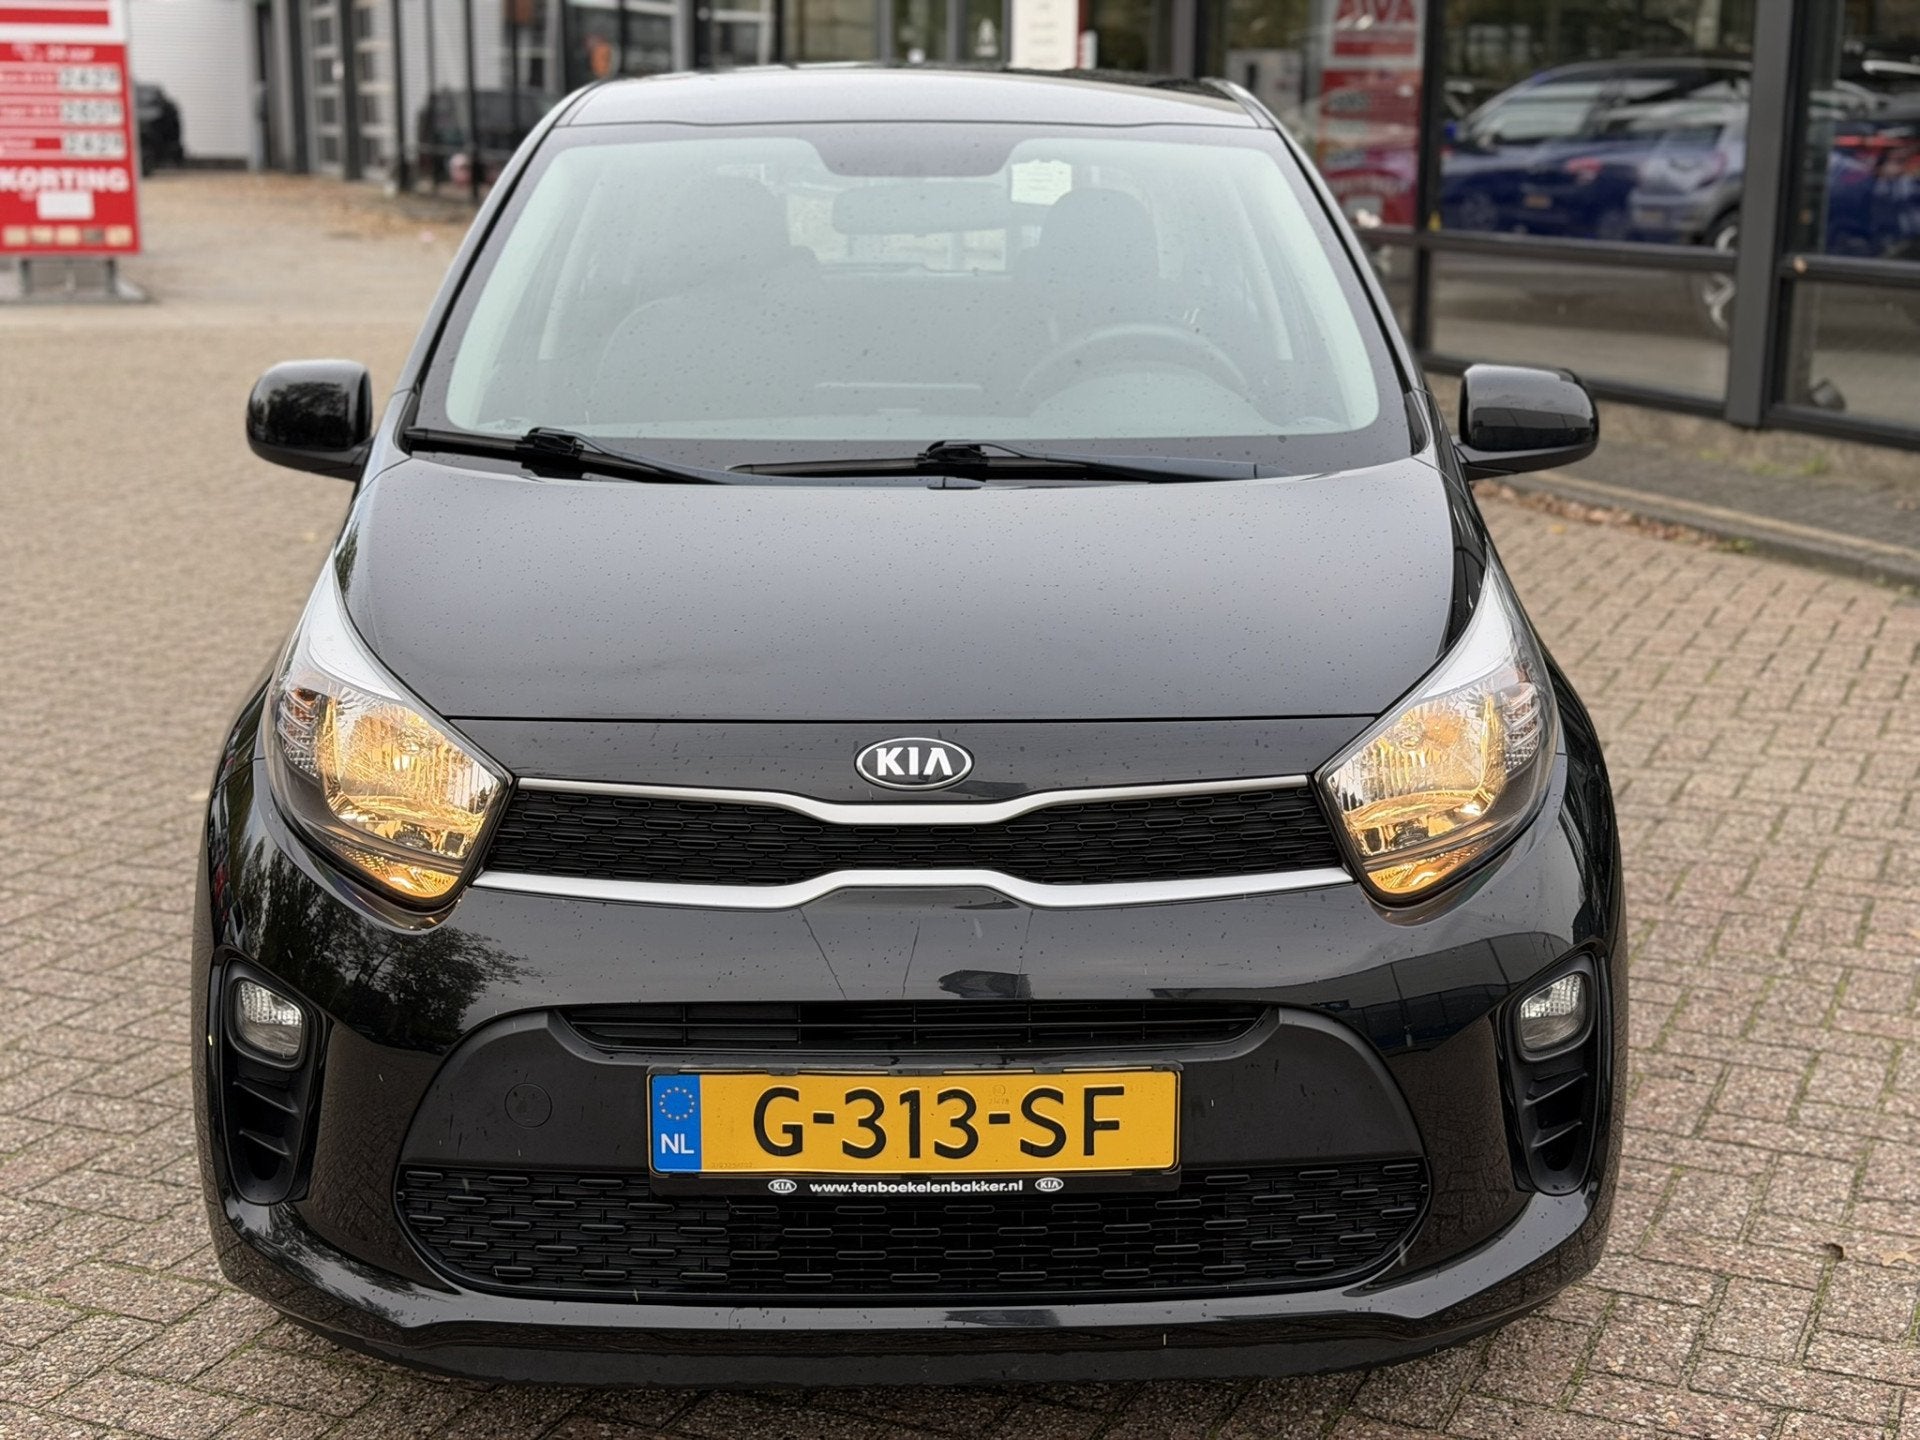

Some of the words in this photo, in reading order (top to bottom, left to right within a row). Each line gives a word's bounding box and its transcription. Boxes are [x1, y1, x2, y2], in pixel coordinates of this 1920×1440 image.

[0, 166, 130, 193] KORTING
[876, 747, 953, 776] KIA
[753, 1085, 1125, 1159] G-313-SF
[661, 1133, 695, 1154] NL
[809, 1180, 1023, 1194] www.tenboekelenbakker.nl
